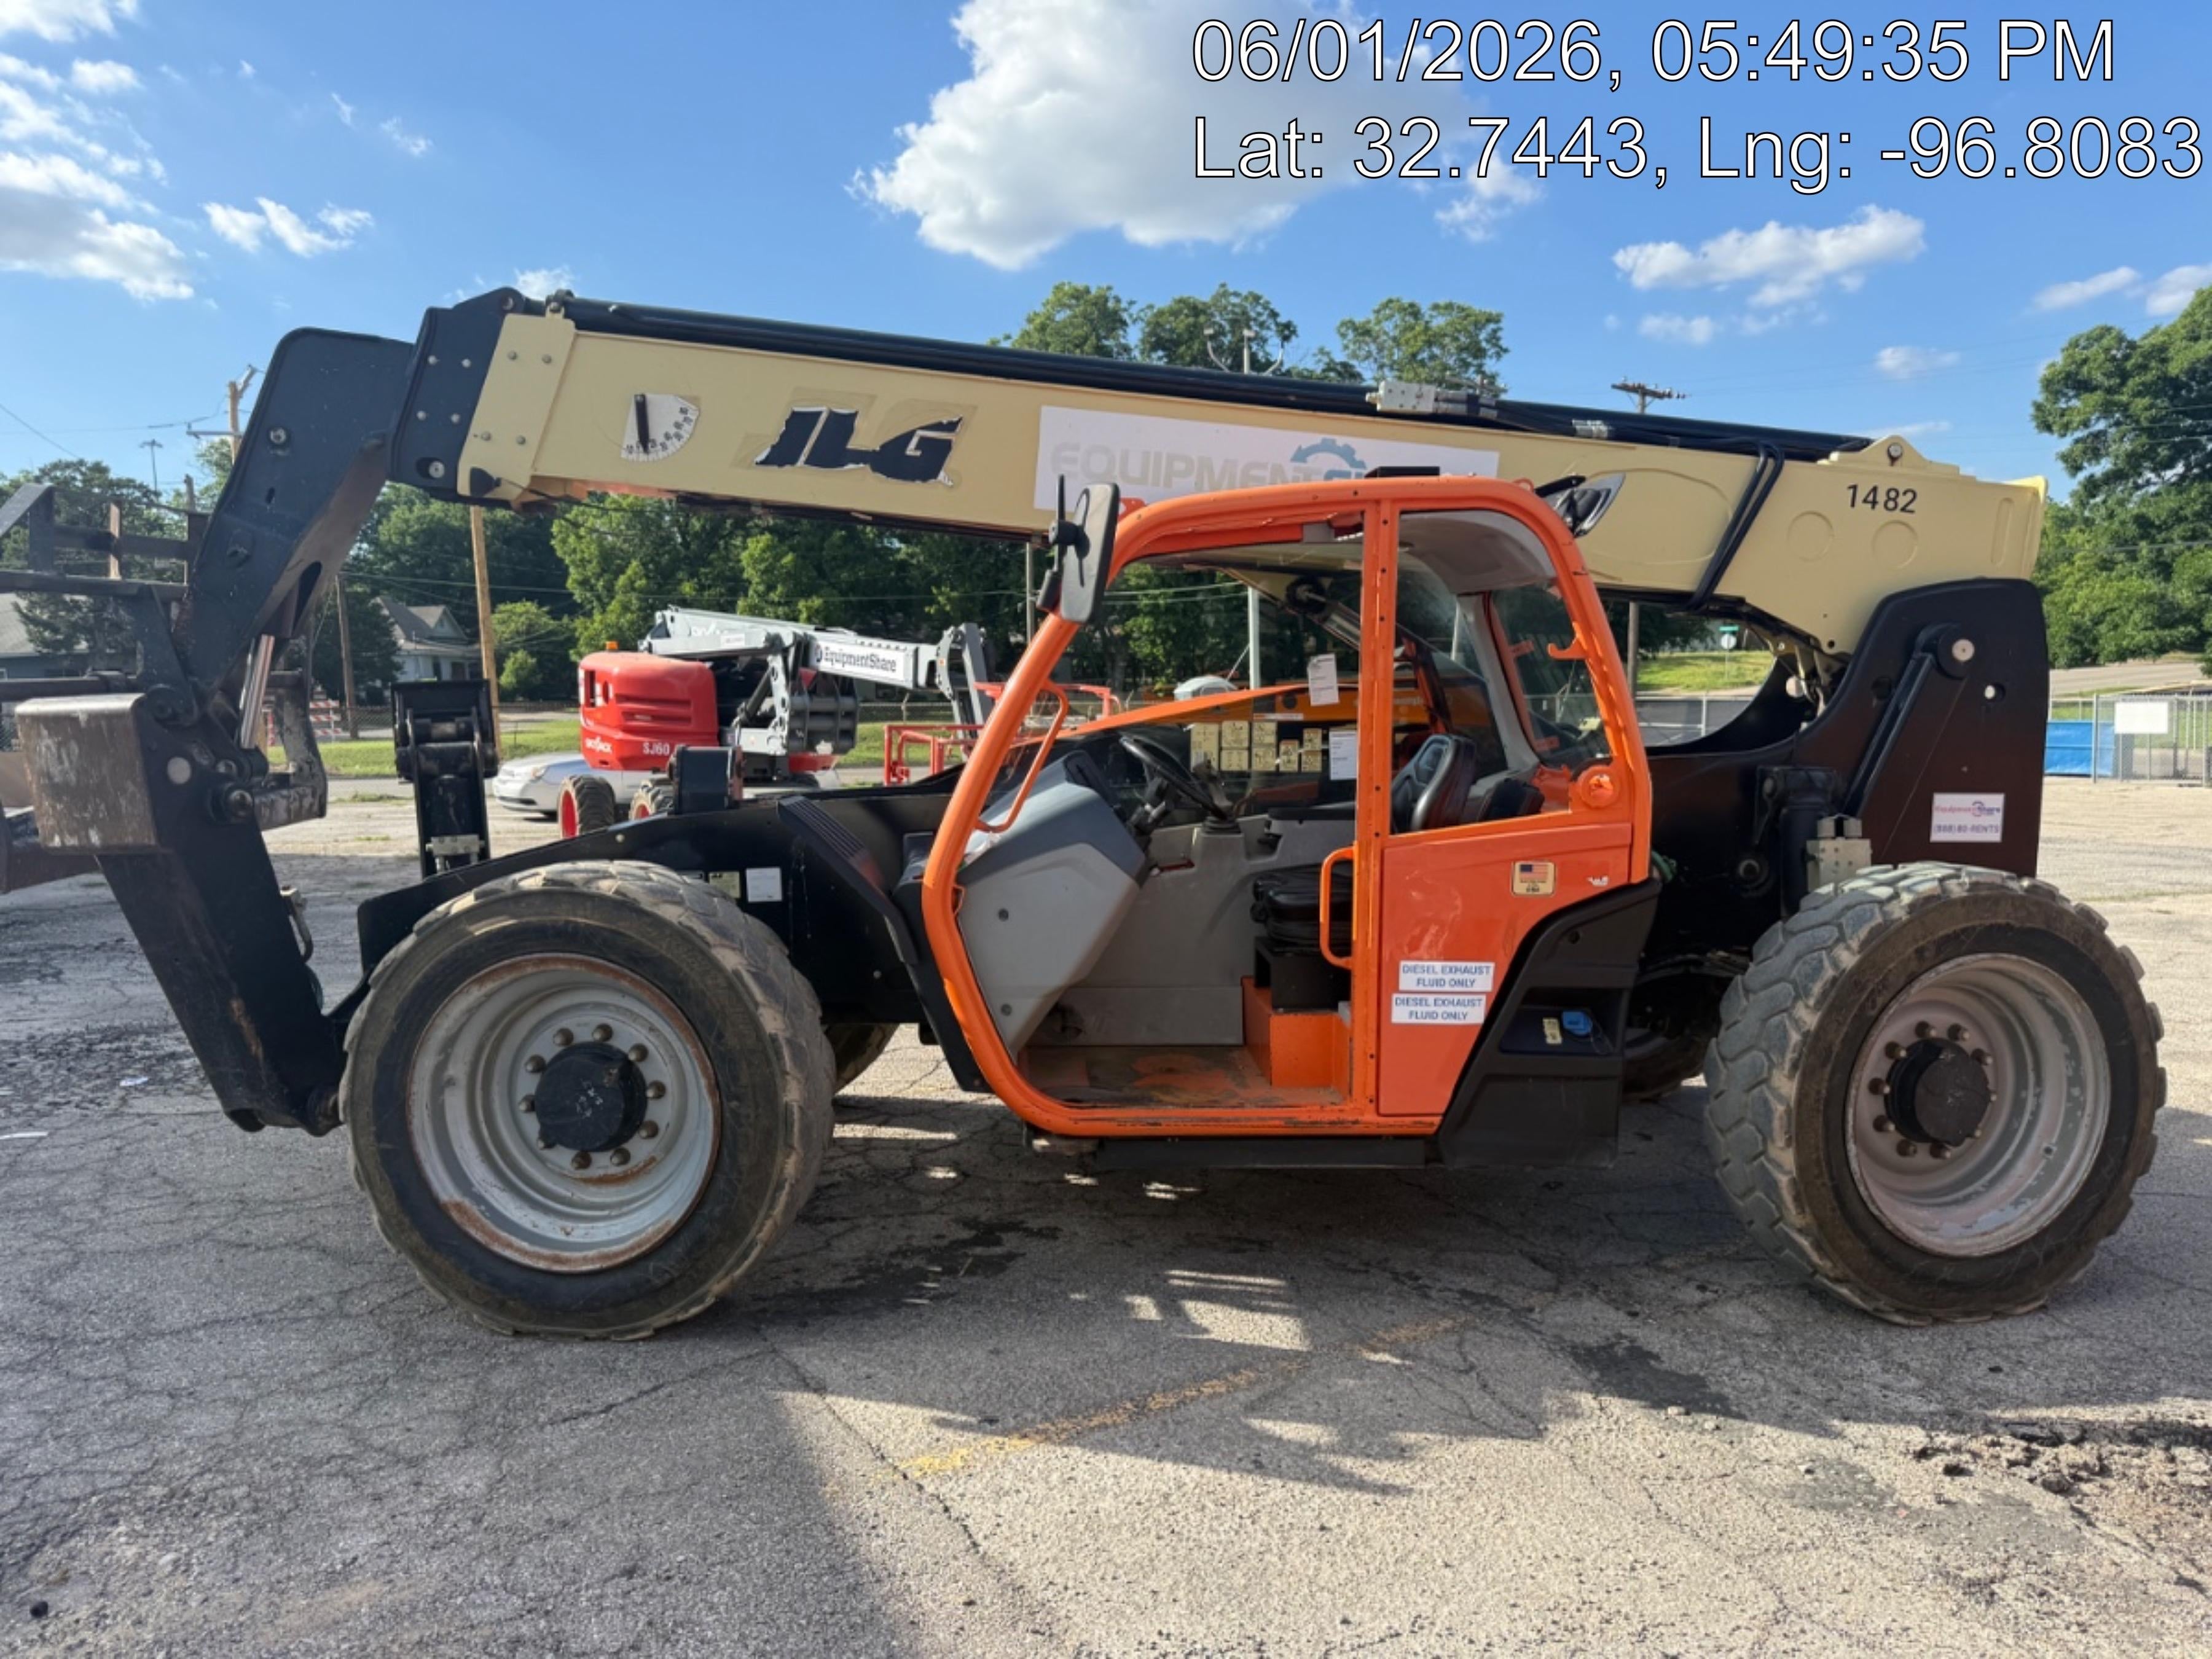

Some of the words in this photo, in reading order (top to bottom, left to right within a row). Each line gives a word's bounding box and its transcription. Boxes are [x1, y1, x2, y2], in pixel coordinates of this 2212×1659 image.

[1847, 484, 1917, 513] 1482
[823, 646, 897, 672] EquipmentShare
[643, 742, 670, 756] SJ60
[1402, 964, 1438, 975] DIESEL
[1441, 965, 1491, 976] EXHAUST
[1416, 978, 1446, 987] FLUID
[1448, 978, 1477, 988] ONLY
[1395, 997, 1431, 1007] DIESEL
[1433, 998, 1483, 1008] EXHAUST
[1408, 1010, 1438, 1020] FLUID
[1441, 1011, 1469, 1021] ONLY
